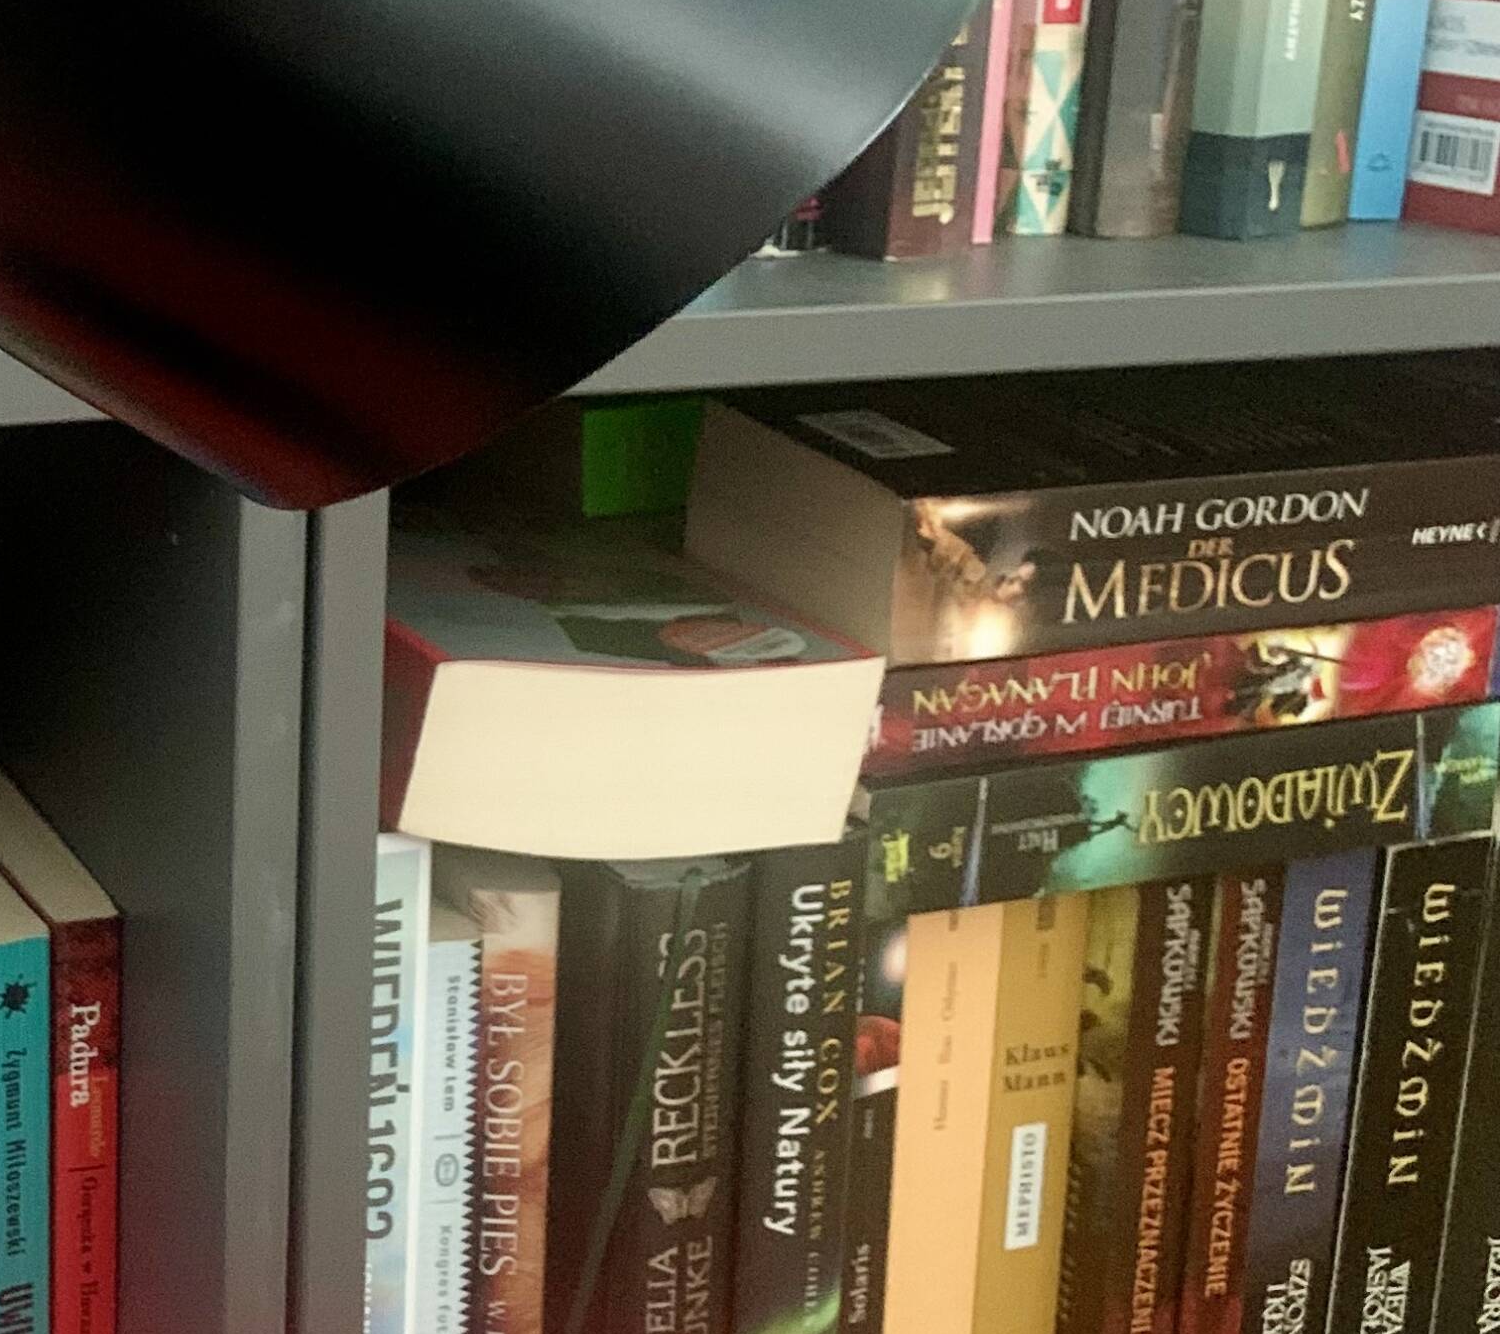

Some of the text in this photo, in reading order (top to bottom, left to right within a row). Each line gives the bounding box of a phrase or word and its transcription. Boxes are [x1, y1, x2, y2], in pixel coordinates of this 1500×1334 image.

[1068, 487, 1371, 542] NOAH GORDON
[1411, 521, 1475, 546] HEYNE
[1062, 537, 1356, 625] MEDICUS
[1137, 749, 1415, 845] ZWIADOWCY
[814, 878, 854, 1126] BRIAN COX
[1155, 882, 1193, 1047] SAPKOWSKI
[1229, 877, 1268, 1041] SAPKOWSKI
[69, 1001, 101, 1108] Padura
[485, 971, 529, 1044] BYŁ
[1004, 1040, 1070, 1068] Klaus
[763, 883, 826, 1237] Ukryte siły Natury
[1001, 1069, 1067, 1094] Mann
[1146, 1065, 1176, 1144] MIECZ
[2, 1047, 29, 1259] Zygmunt Miłoszewski
[483, 1061, 524, 1179] SOBIE
[1215, 1057, 1250, 1174] OSTATNIE
[1014, 1130, 1038, 1238] MEPHISTO
[478, 1193, 521, 1277] PIES
[849, 1243, 872, 1325] Solaris
